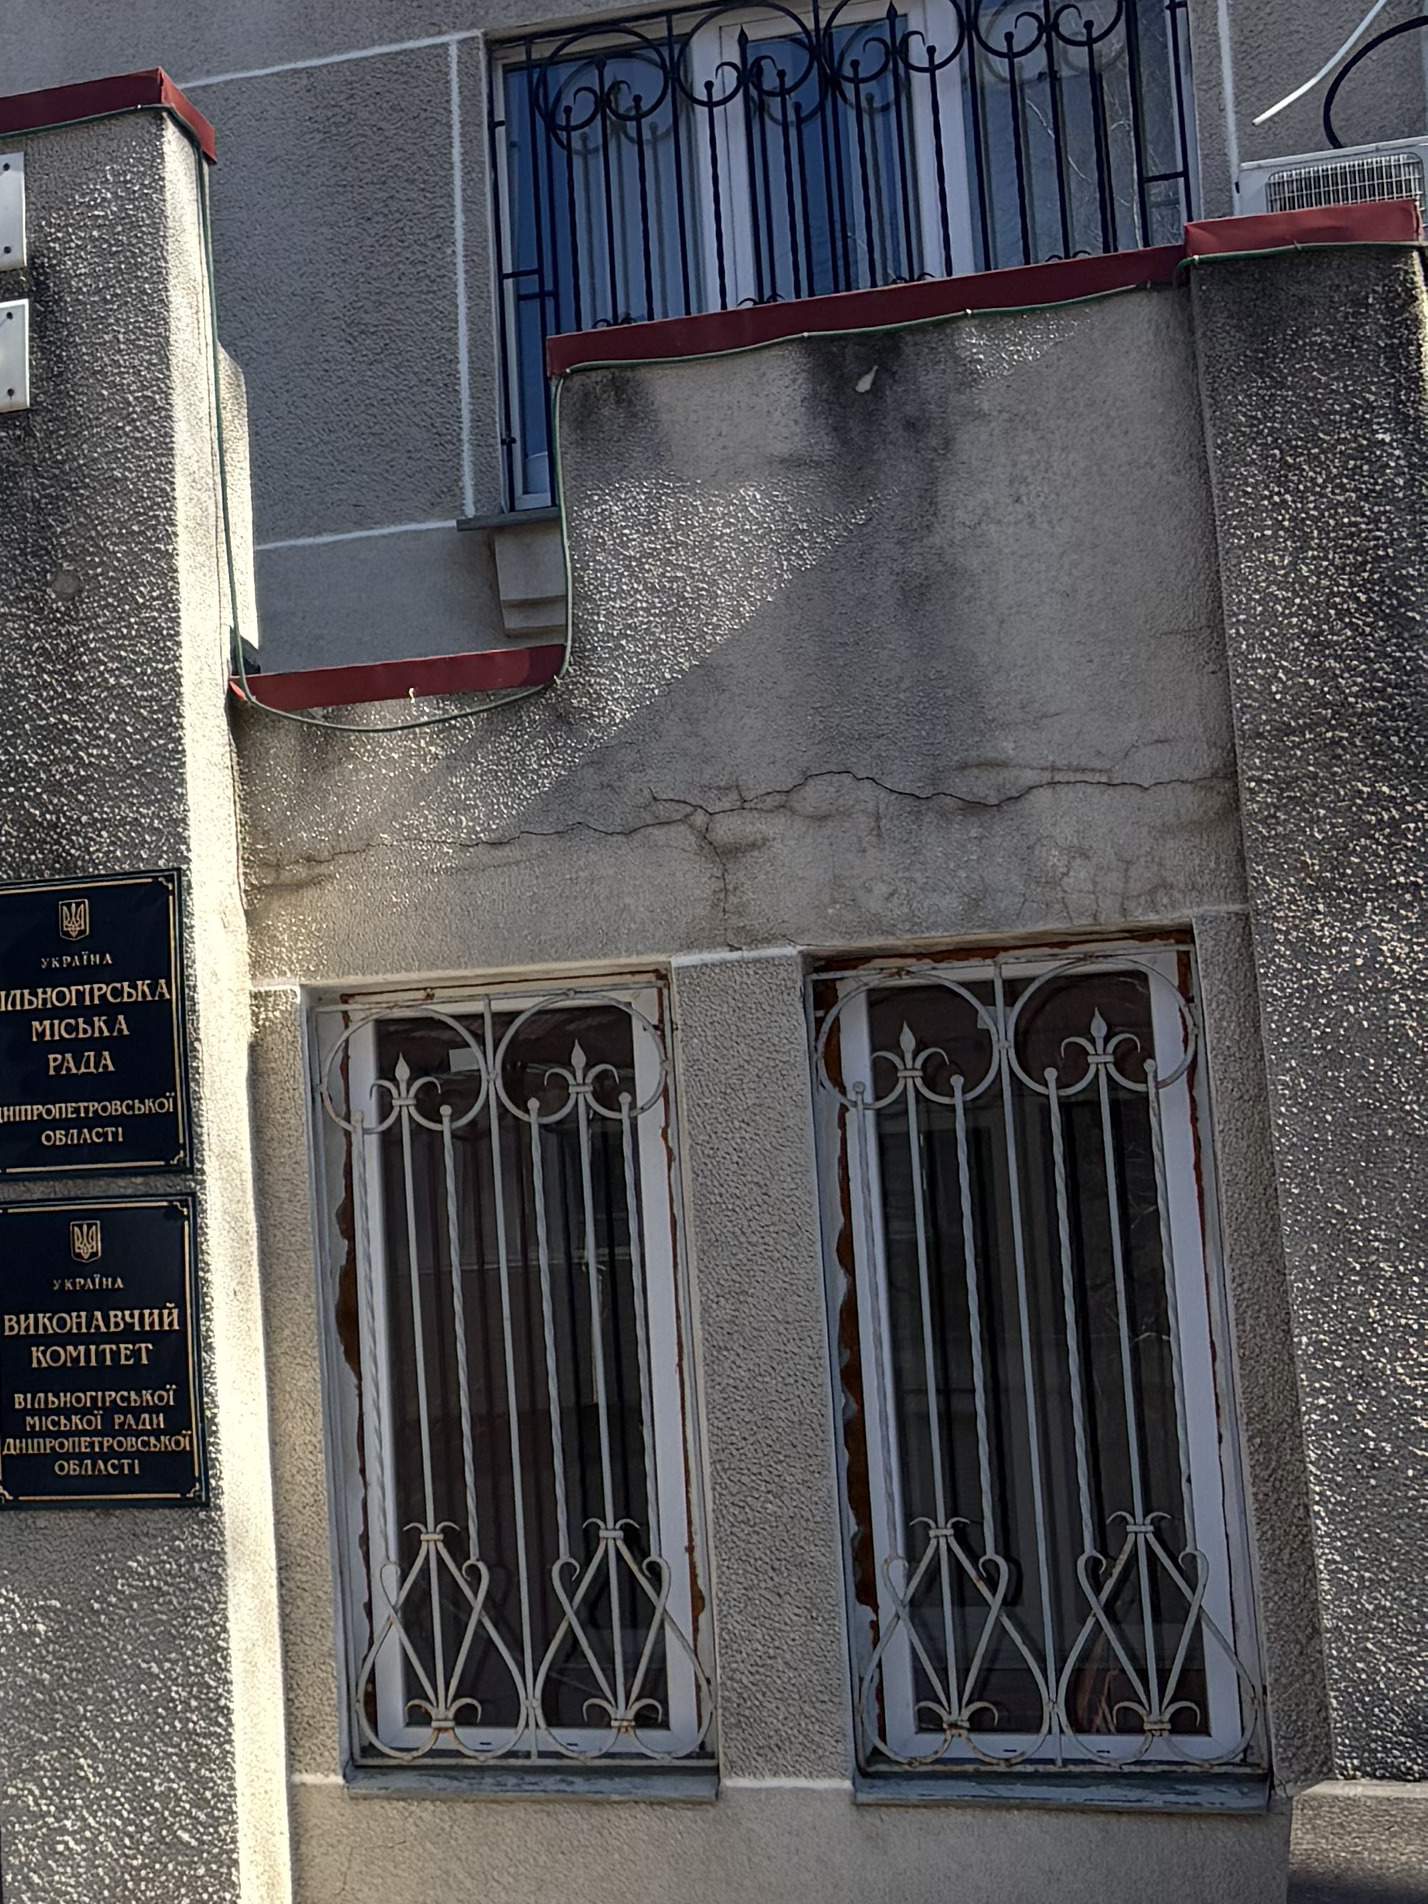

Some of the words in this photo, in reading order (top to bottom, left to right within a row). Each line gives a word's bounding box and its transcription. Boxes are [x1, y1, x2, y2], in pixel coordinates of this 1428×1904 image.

[41, 952, 112, 969] УКРАЇНА
[31, 1015, 130, 1041] МІСЬКА
[48, 1051, 115, 1076] РАДА
[41, 1127, 123, 1146] ОБЛАСТІ
[52, 1273, 124, 1290] УКРАЇНА
[3, 1302, 180, 1336] ВИКОНАВЧИЙ
[31, 1343, 154, 1368] КОМІТЕТ
[14, 1384, 177, 1410] ВІЛЬНОГІРСЬКОЇ
[25, 1410, 102, 1431] МІСЬКОЇ
[114, 1413, 165, 1430] РАДИ
[2, 1431, 192, 1455] ДНІПРОПЕТРОВСЬКОЇ
[54, 1459, 140, 1476] ОБЛАСТІ
